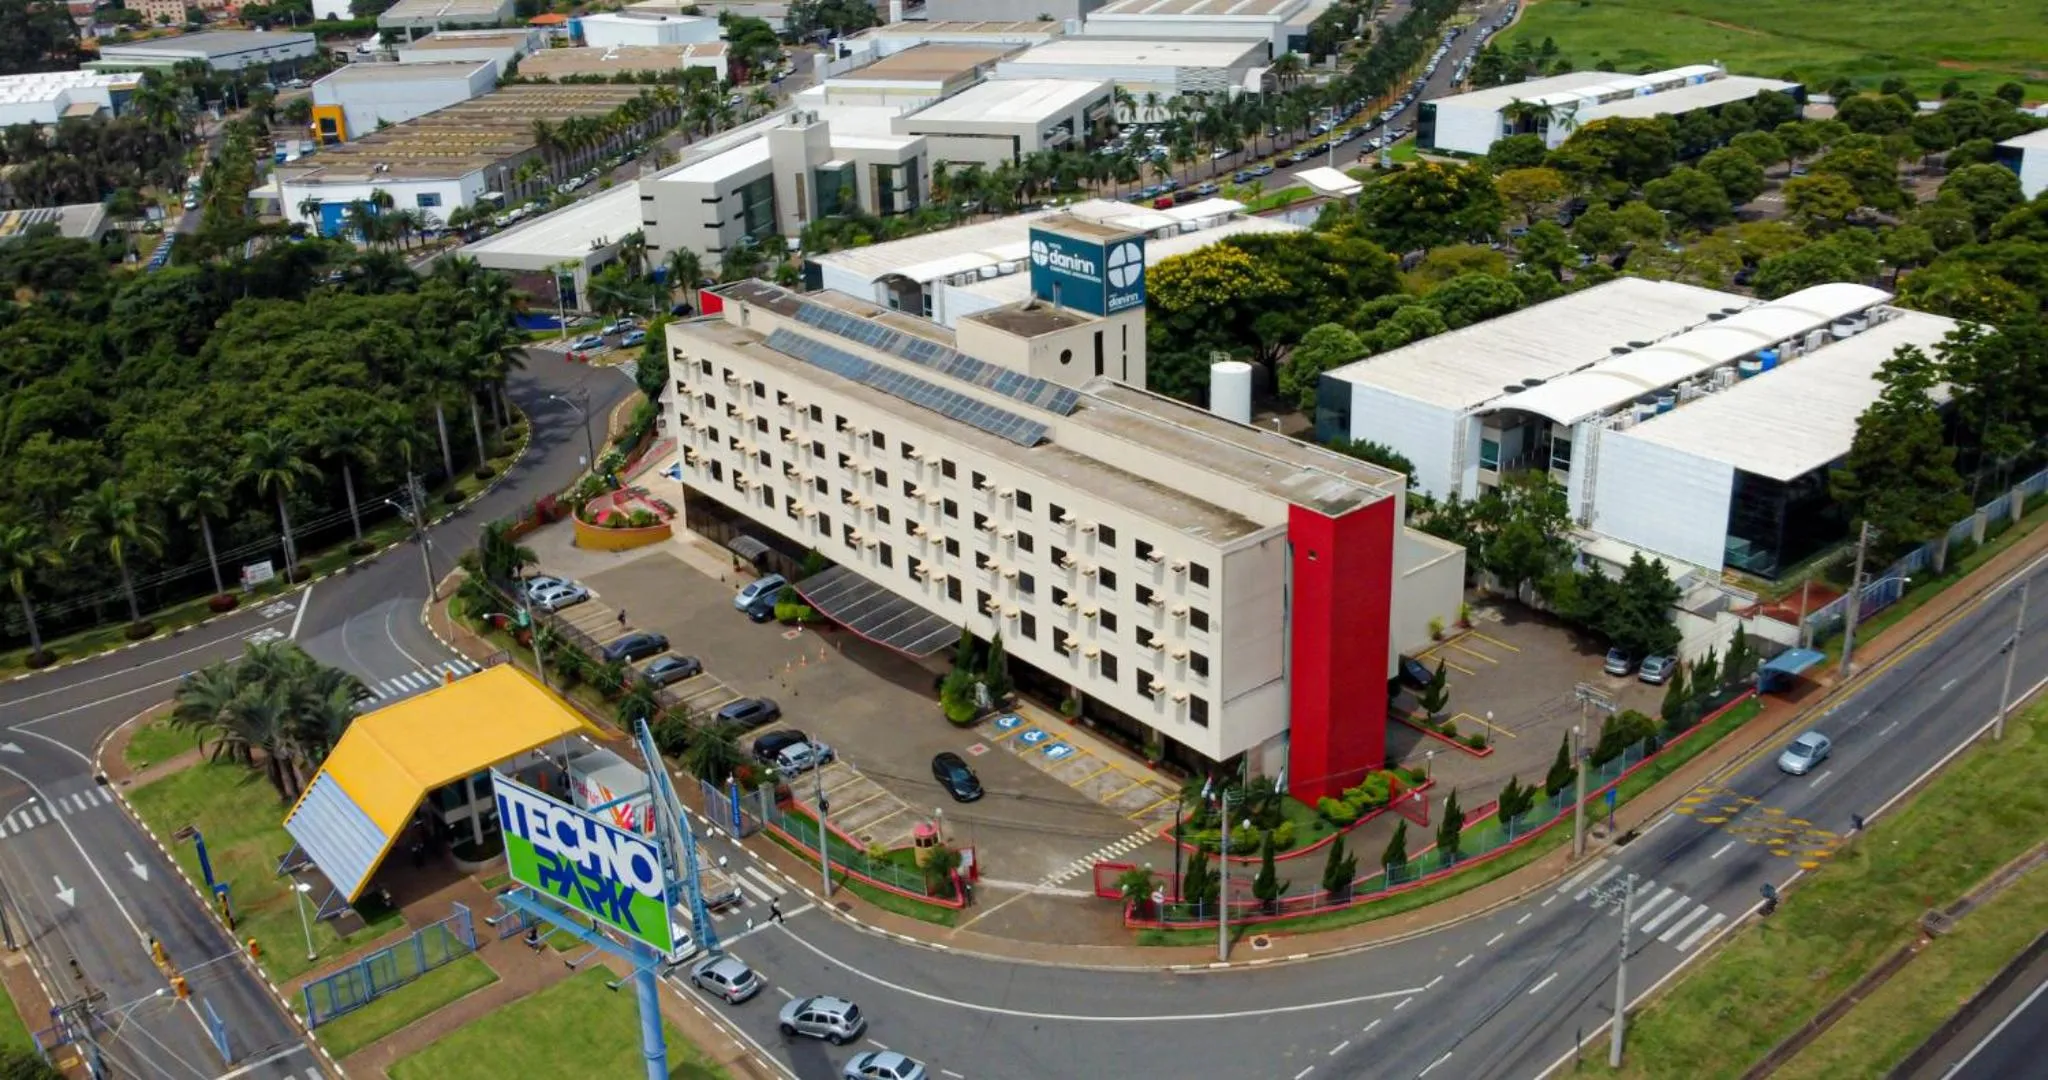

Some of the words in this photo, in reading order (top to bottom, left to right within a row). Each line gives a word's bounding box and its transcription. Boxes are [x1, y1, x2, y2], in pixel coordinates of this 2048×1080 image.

[1050, 249, 1095, 275] daninn
[497, 781, 665, 898] TECHNO
[534, 845, 642, 934] PARK
